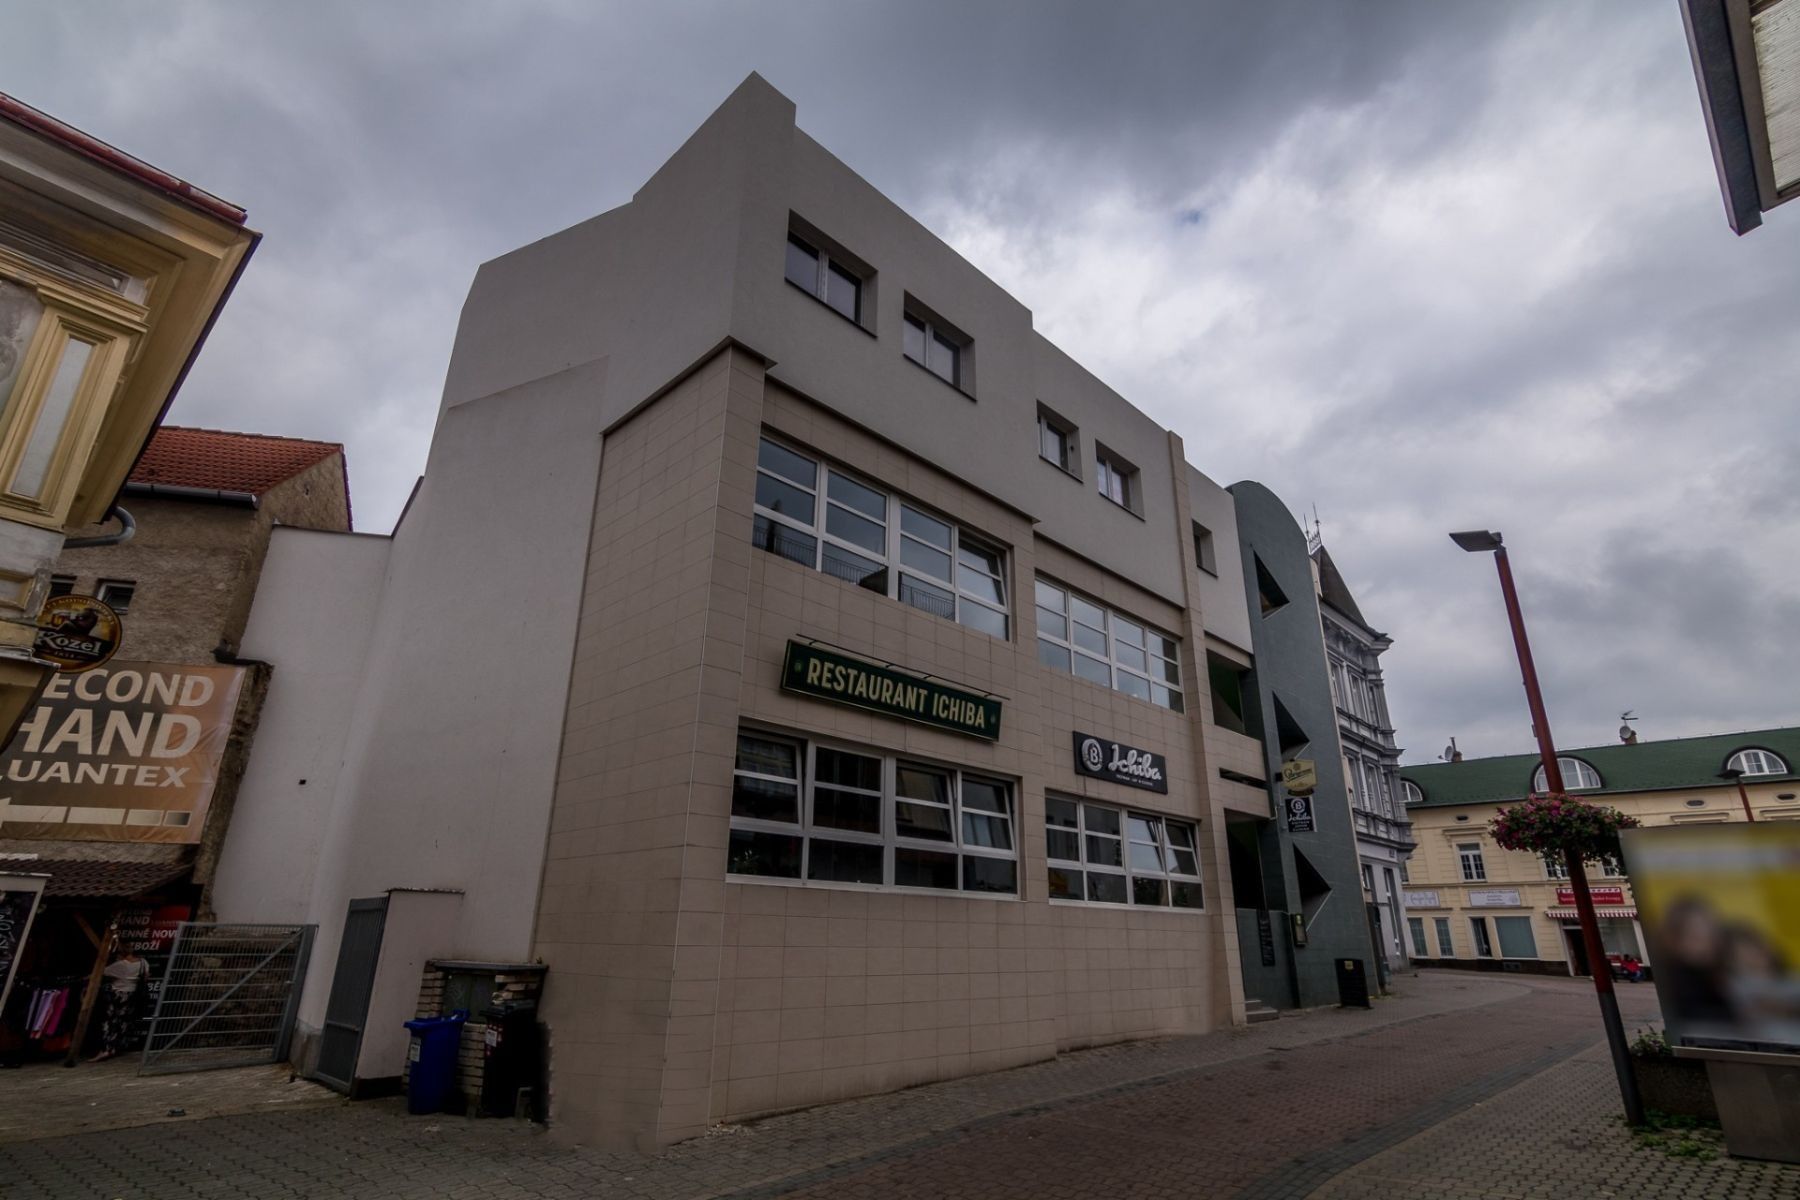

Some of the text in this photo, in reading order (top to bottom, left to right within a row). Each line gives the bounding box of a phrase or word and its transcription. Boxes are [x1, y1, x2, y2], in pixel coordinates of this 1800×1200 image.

[36, 632, 102, 653] Kozel
[42, 669, 214, 707] ECOND
[806, 657, 985, 728] RESTAURANT ICHIBA
[0, 760, 190, 787] UANTEX
[1108, 744, 1162, 780] Ichiba
[152, 929, 178, 939] NOV
